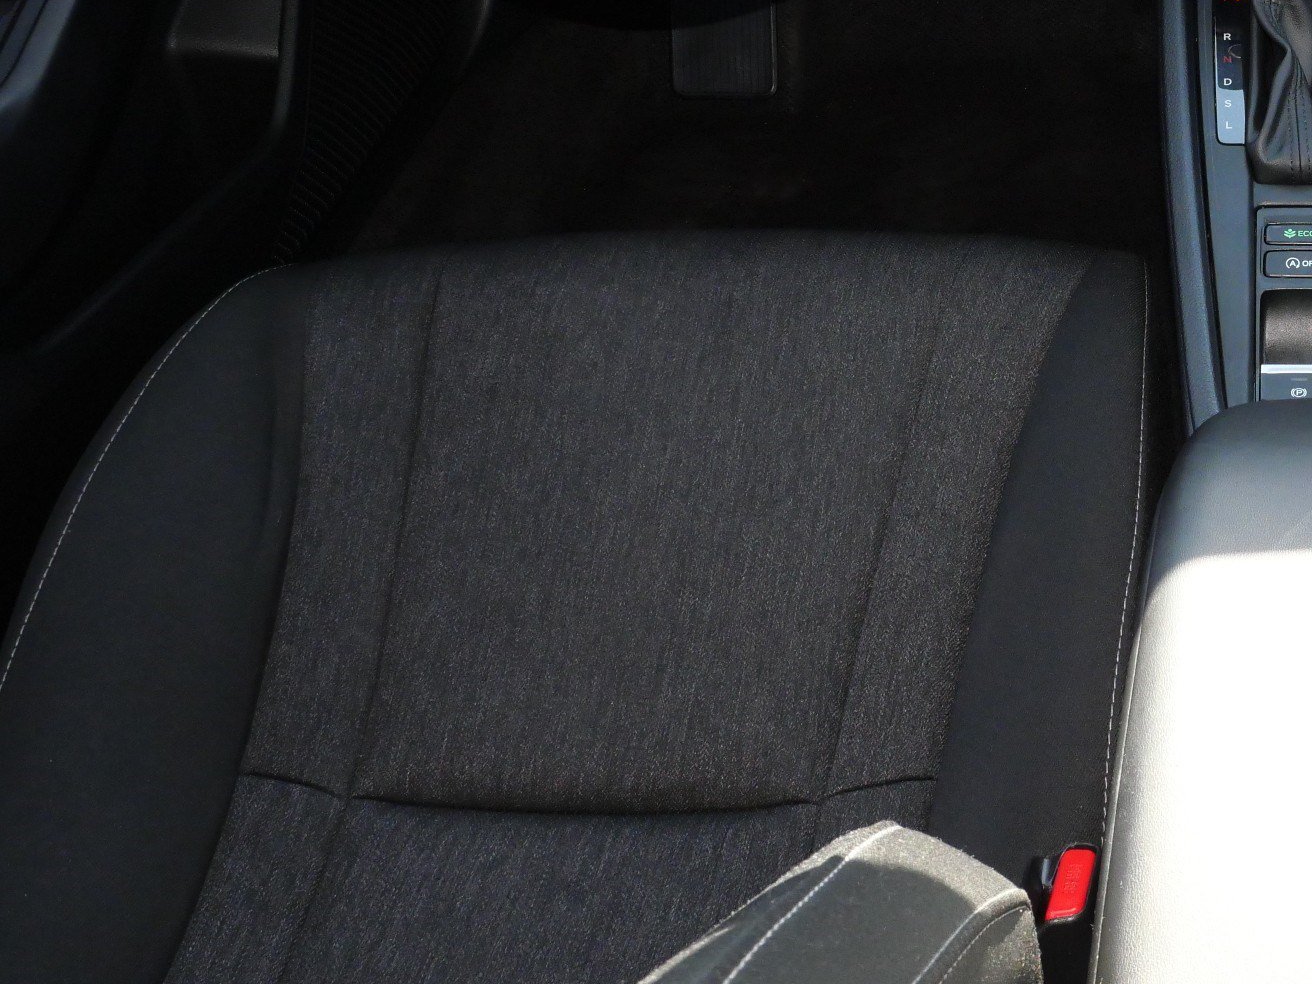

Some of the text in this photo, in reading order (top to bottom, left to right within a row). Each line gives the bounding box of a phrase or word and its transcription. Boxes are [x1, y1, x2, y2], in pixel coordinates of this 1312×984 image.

[1223, 33, 1232, 41] R
[1223, 78, 1232, 86] D
[1224, 99, 1232, 108] S
[1225, 121, 1233, 129] L
